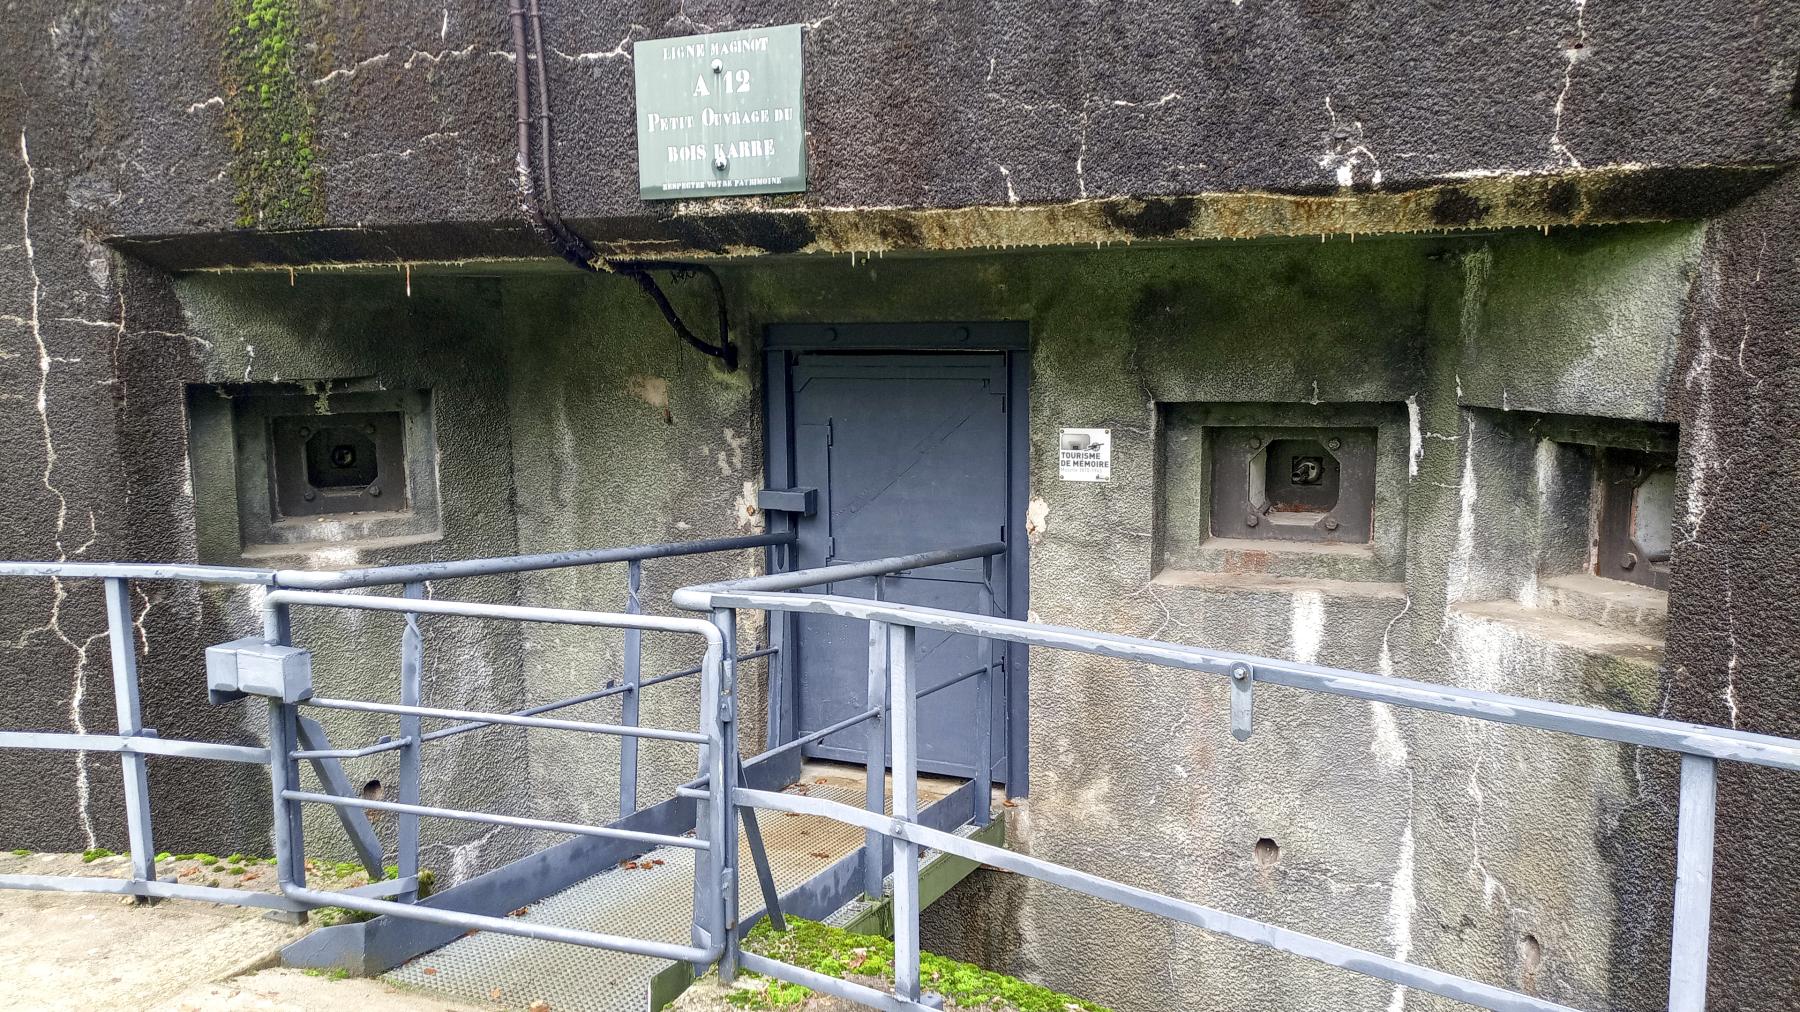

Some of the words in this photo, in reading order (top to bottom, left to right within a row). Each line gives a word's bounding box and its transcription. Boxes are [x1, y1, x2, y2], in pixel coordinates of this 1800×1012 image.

[663, 44, 704, 60] LIGNE
[710, 37, 769, 54] MAGINOT
[693, 74, 710, 97] A
[723, 69, 751, 93] 12
[774, 108, 793, 122] DU
[667, 145, 707, 162] BOIS
[714, 138, 774, 159] KARRE
